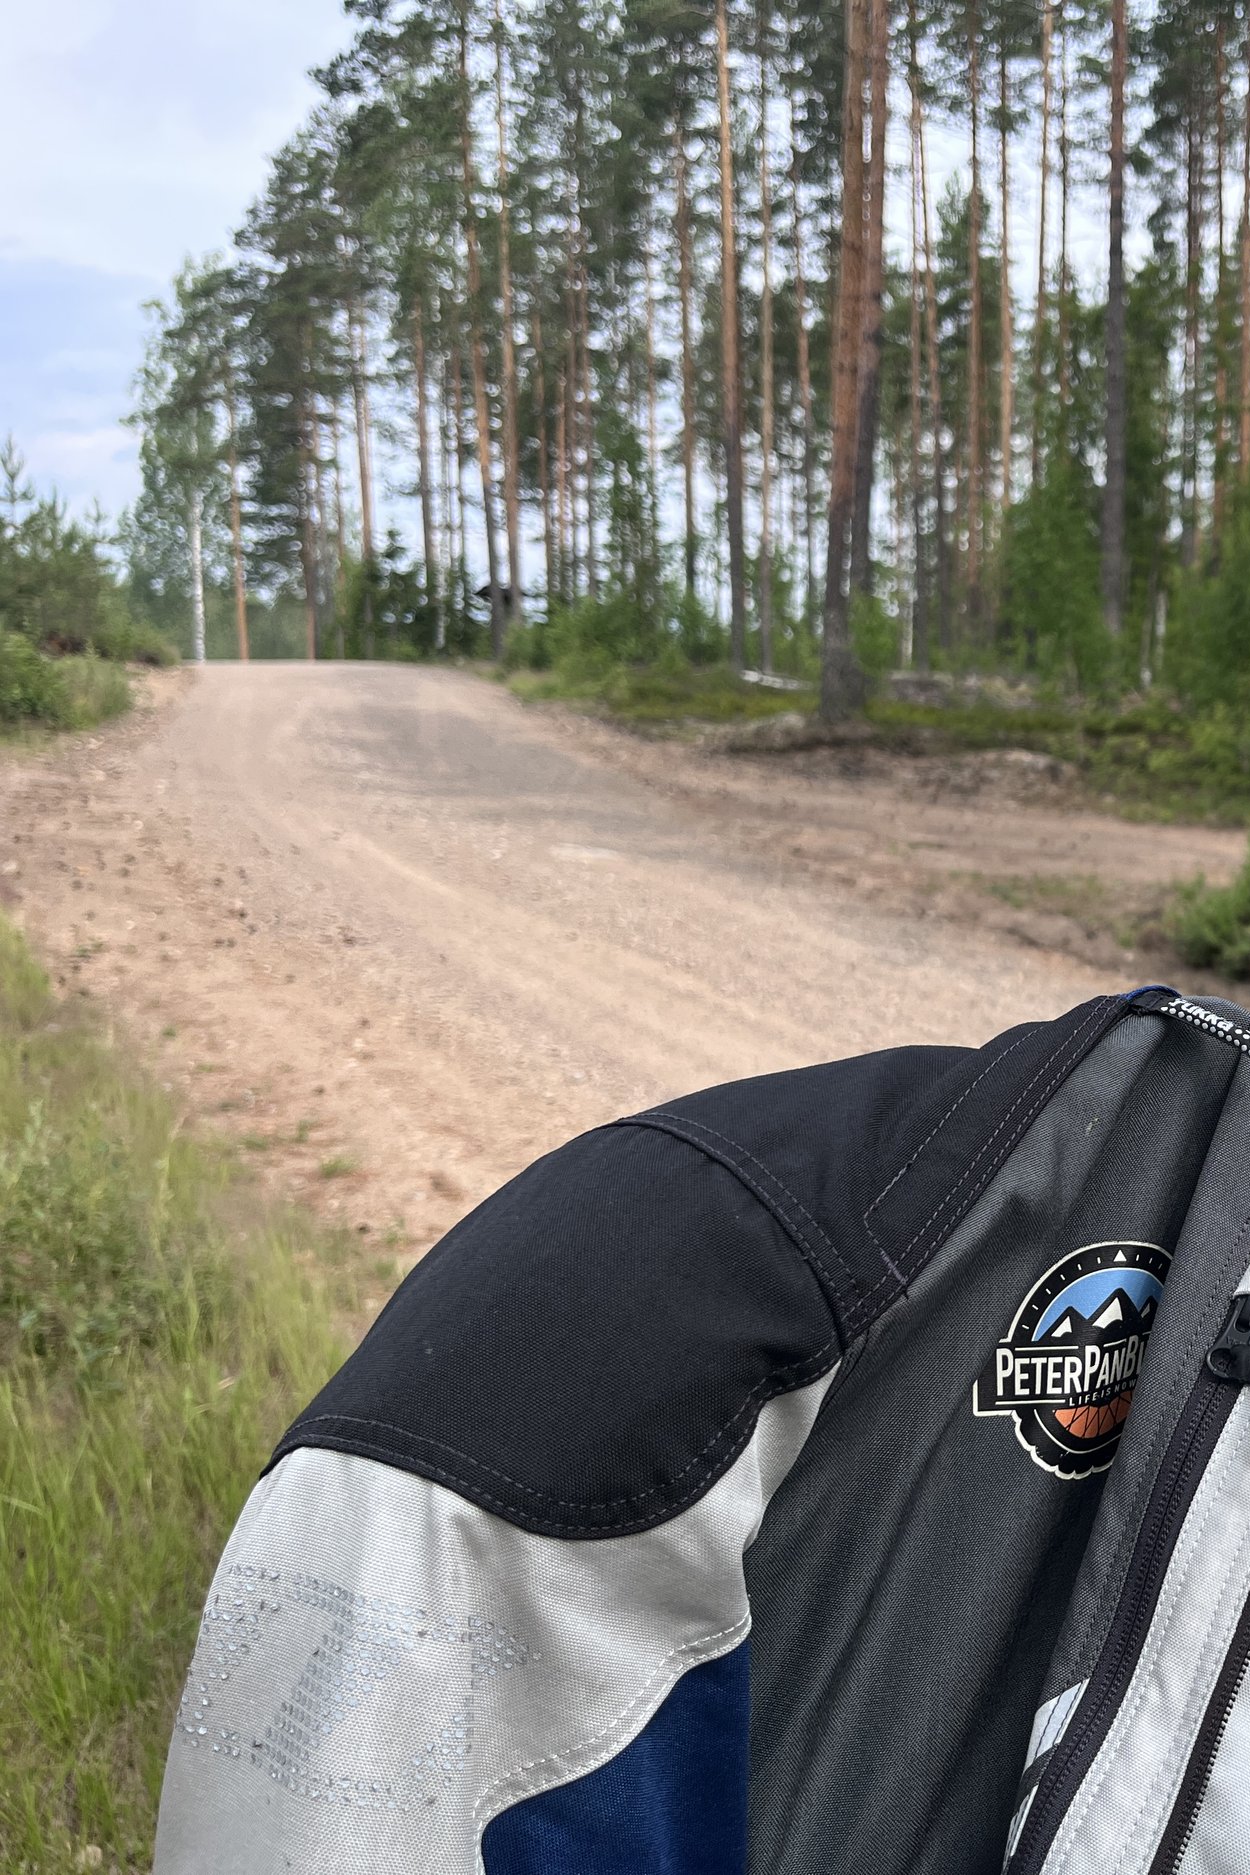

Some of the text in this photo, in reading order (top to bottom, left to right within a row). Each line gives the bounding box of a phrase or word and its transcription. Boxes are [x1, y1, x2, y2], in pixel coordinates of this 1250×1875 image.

[1069, 1379, 1137, 1406] LIFE IS NOW
